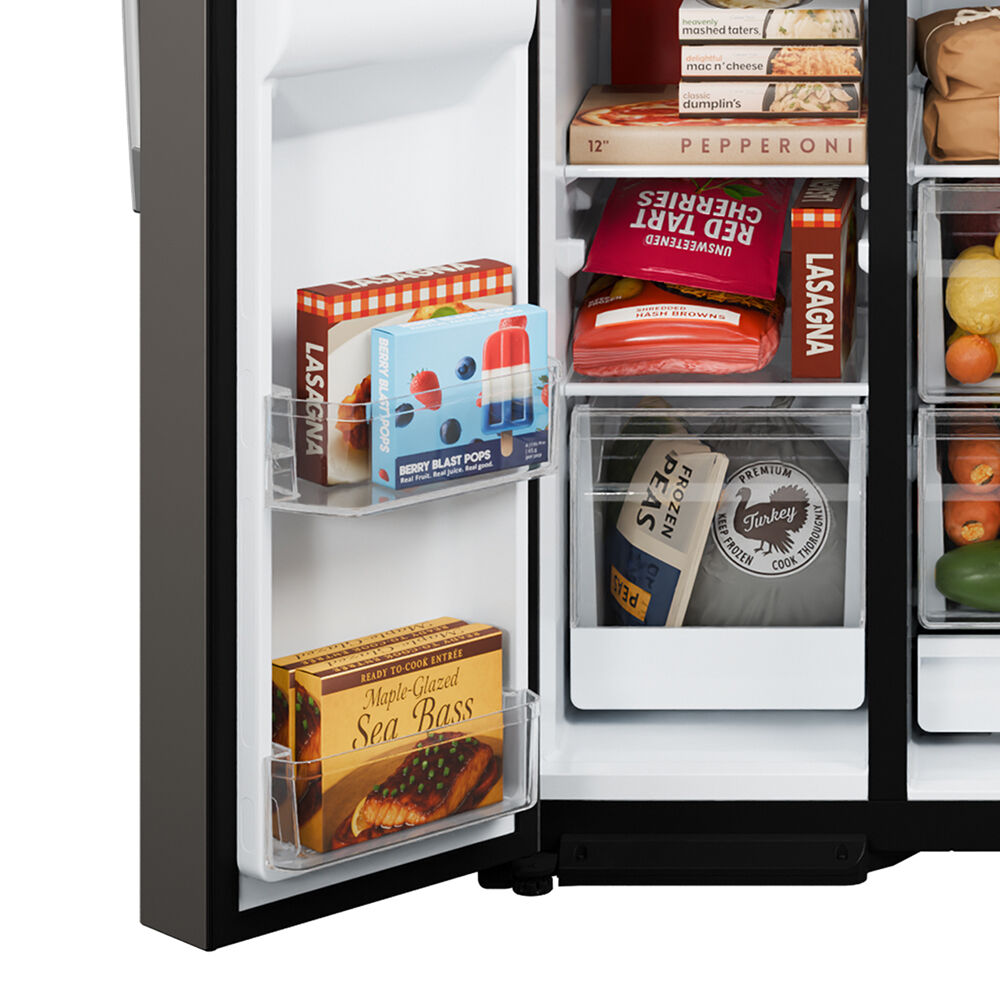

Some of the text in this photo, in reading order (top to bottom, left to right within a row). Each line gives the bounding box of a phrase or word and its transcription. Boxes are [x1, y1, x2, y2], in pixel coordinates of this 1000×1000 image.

[681, 25, 727, 36] mashed
[682, 18, 719, 28] heavenly
[686, 62, 712, 71] mac
[726, 61, 764, 71] cheese
[682, 91, 711, 100] classic
[682, 97, 742, 111] dumplin's
[587, 137, 853, 154] 12" PEPPERONI
[635, 188, 763, 224] CHERRIES
[628, 207, 755, 246] RED TART
[644, 233, 733, 258] UNSWEETENED
[334, 261, 482, 290] LASAGNA
[635, 310, 726, 320] HASH BROWNS
[804, 252, 836, 357] LASAGNA
[305, 341, 325, 457] LASAGNA
[378, 336, 391, 455] BERRY BLAST POPS
[399, 449, 492, 477] BERRY BLAST POPS
[399, 474, 415, 484] Real
[415, 472, 432, 482] Fruit.
[432, 469, 447, 479] Real
[465, 464, 477, 473] Real
[477, 461, 495, 472] good.
[738, 465, 793, 484] PREMIUM
[636, 453, 679, 532] PEAS
[661, 464, 693, 539] FROZEN
[742, 504, 797, 533] Turkey
[717, 512, 755, 567] KEEP FROZEN
[771, 555, 799, 571] COOK
[360, 667, 388, 683] READY
[430, 648, 464, 666] ENTRÉE
[362, 667, 461, 712] Maple-Glazed
[351, 696, 475, 750] Sea Bass
